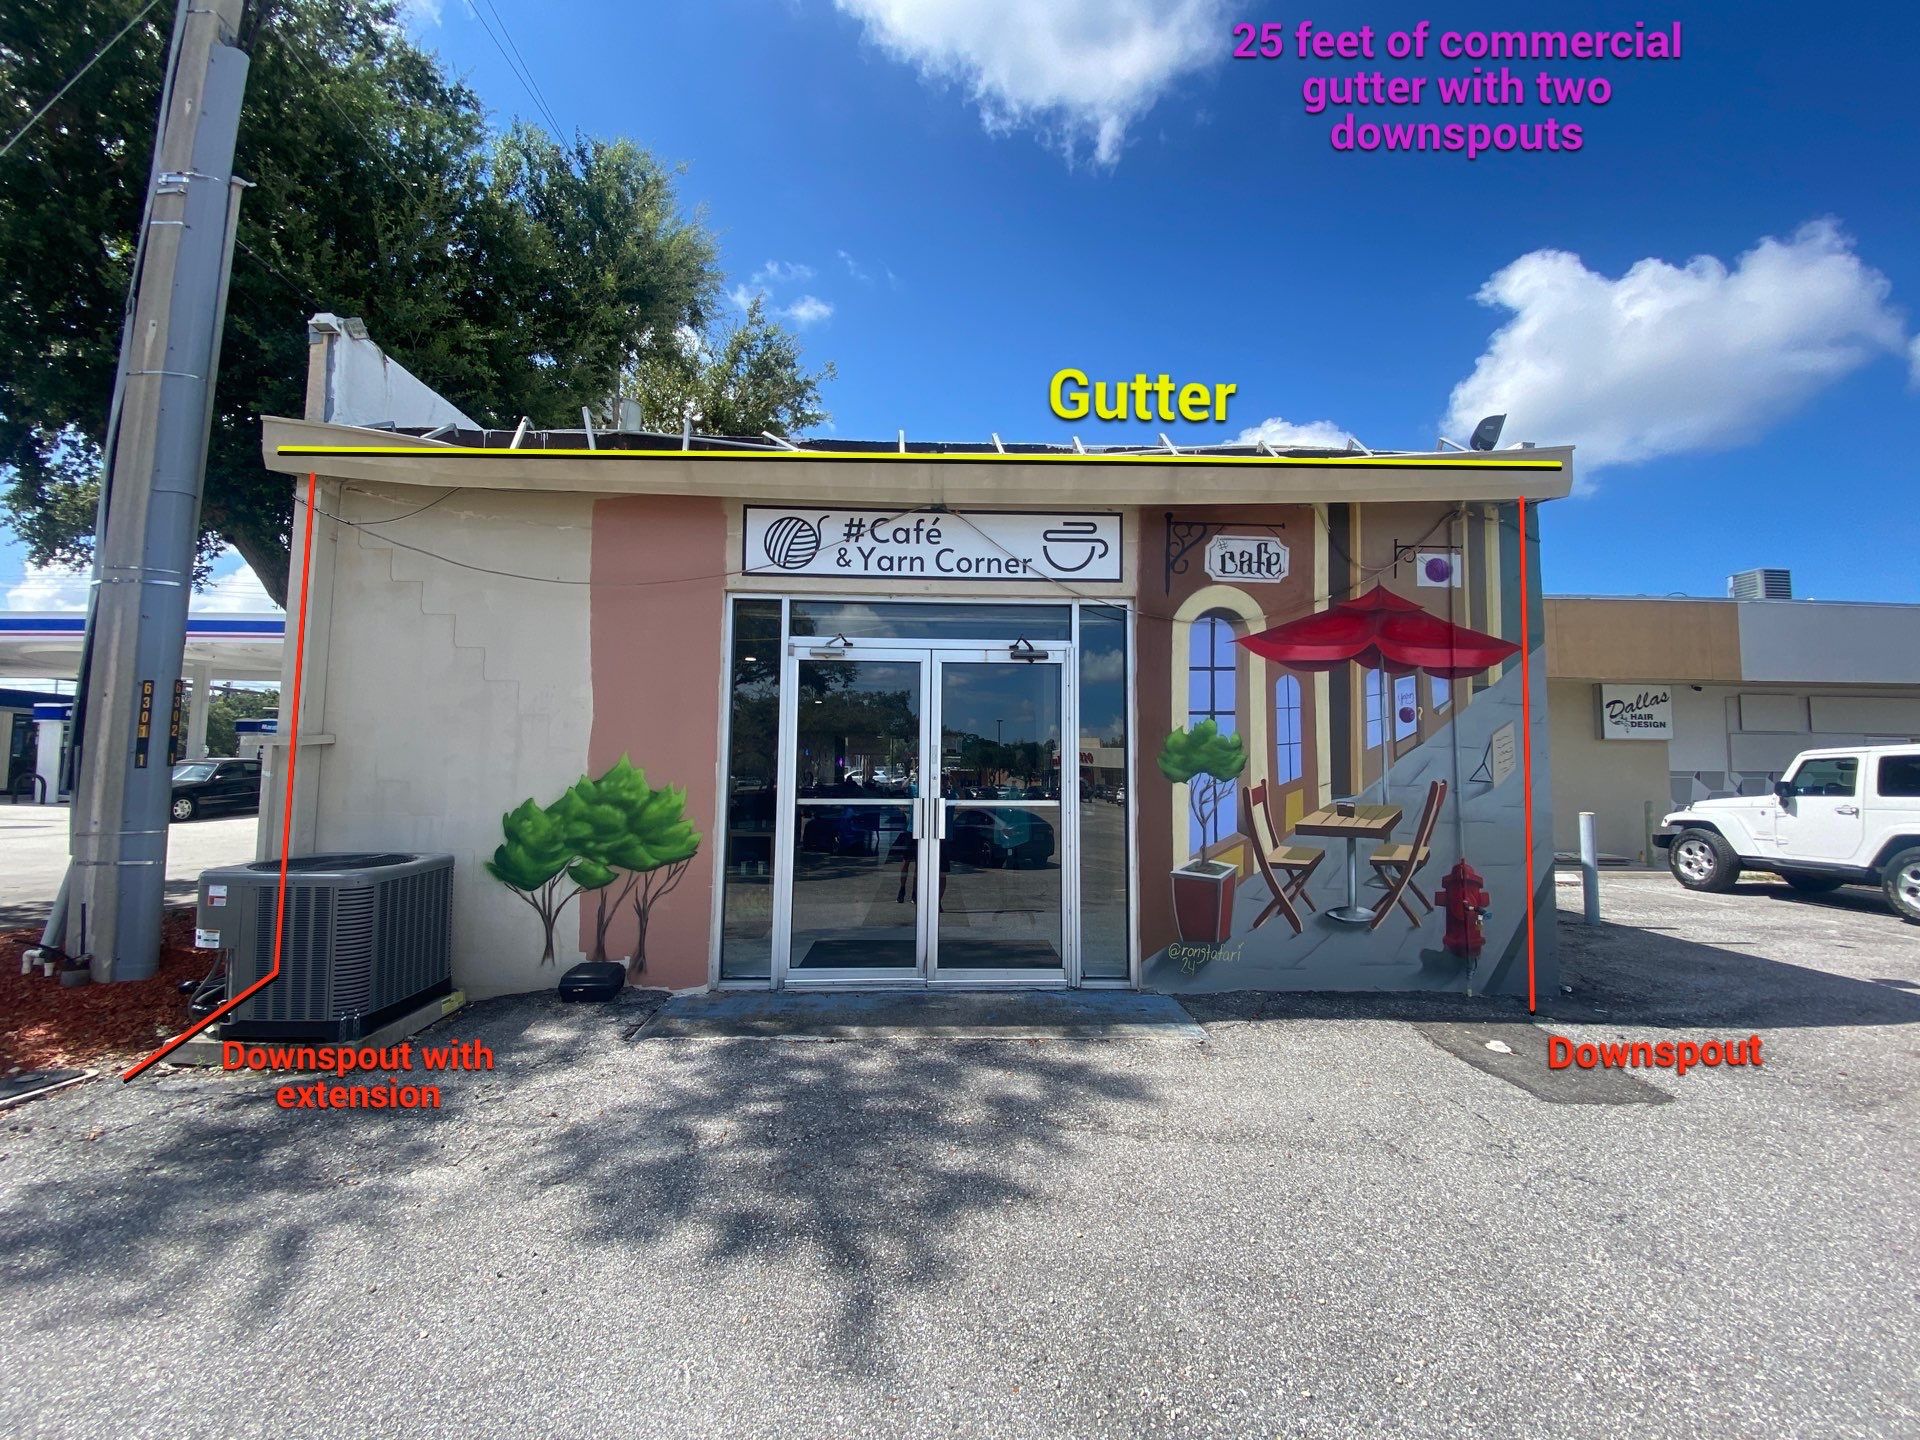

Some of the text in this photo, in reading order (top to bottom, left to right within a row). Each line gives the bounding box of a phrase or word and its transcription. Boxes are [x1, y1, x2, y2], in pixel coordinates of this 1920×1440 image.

[842, 516, 942, 545] #Café
[857, 546, 925, 572] Yarn
[935, 548, 1033, 574] Corner
[1605, 691, 1670, 719] Dallas
[1630, 713, 1654, 721] HAIR
